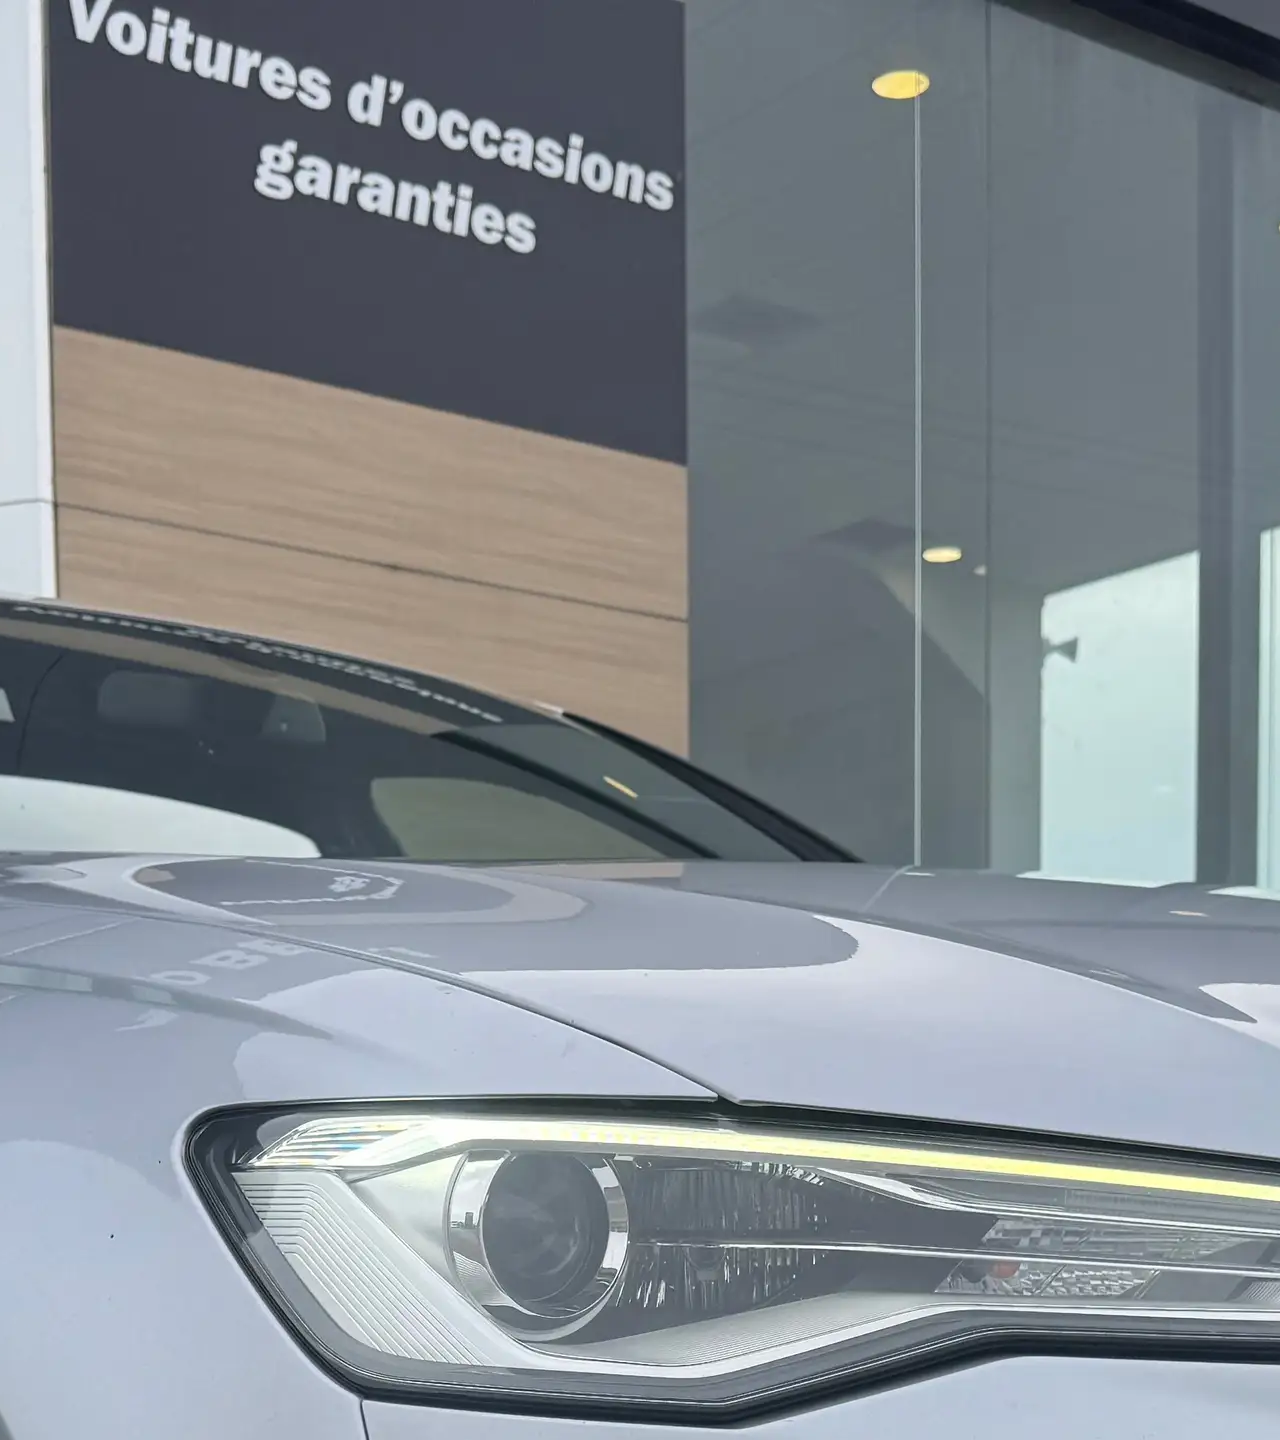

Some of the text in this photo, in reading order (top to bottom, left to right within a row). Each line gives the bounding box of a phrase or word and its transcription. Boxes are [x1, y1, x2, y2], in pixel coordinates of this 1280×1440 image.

[69, 0, 675, 212] Voitures d'occasions
[253, 139, 537, 255] garanties
